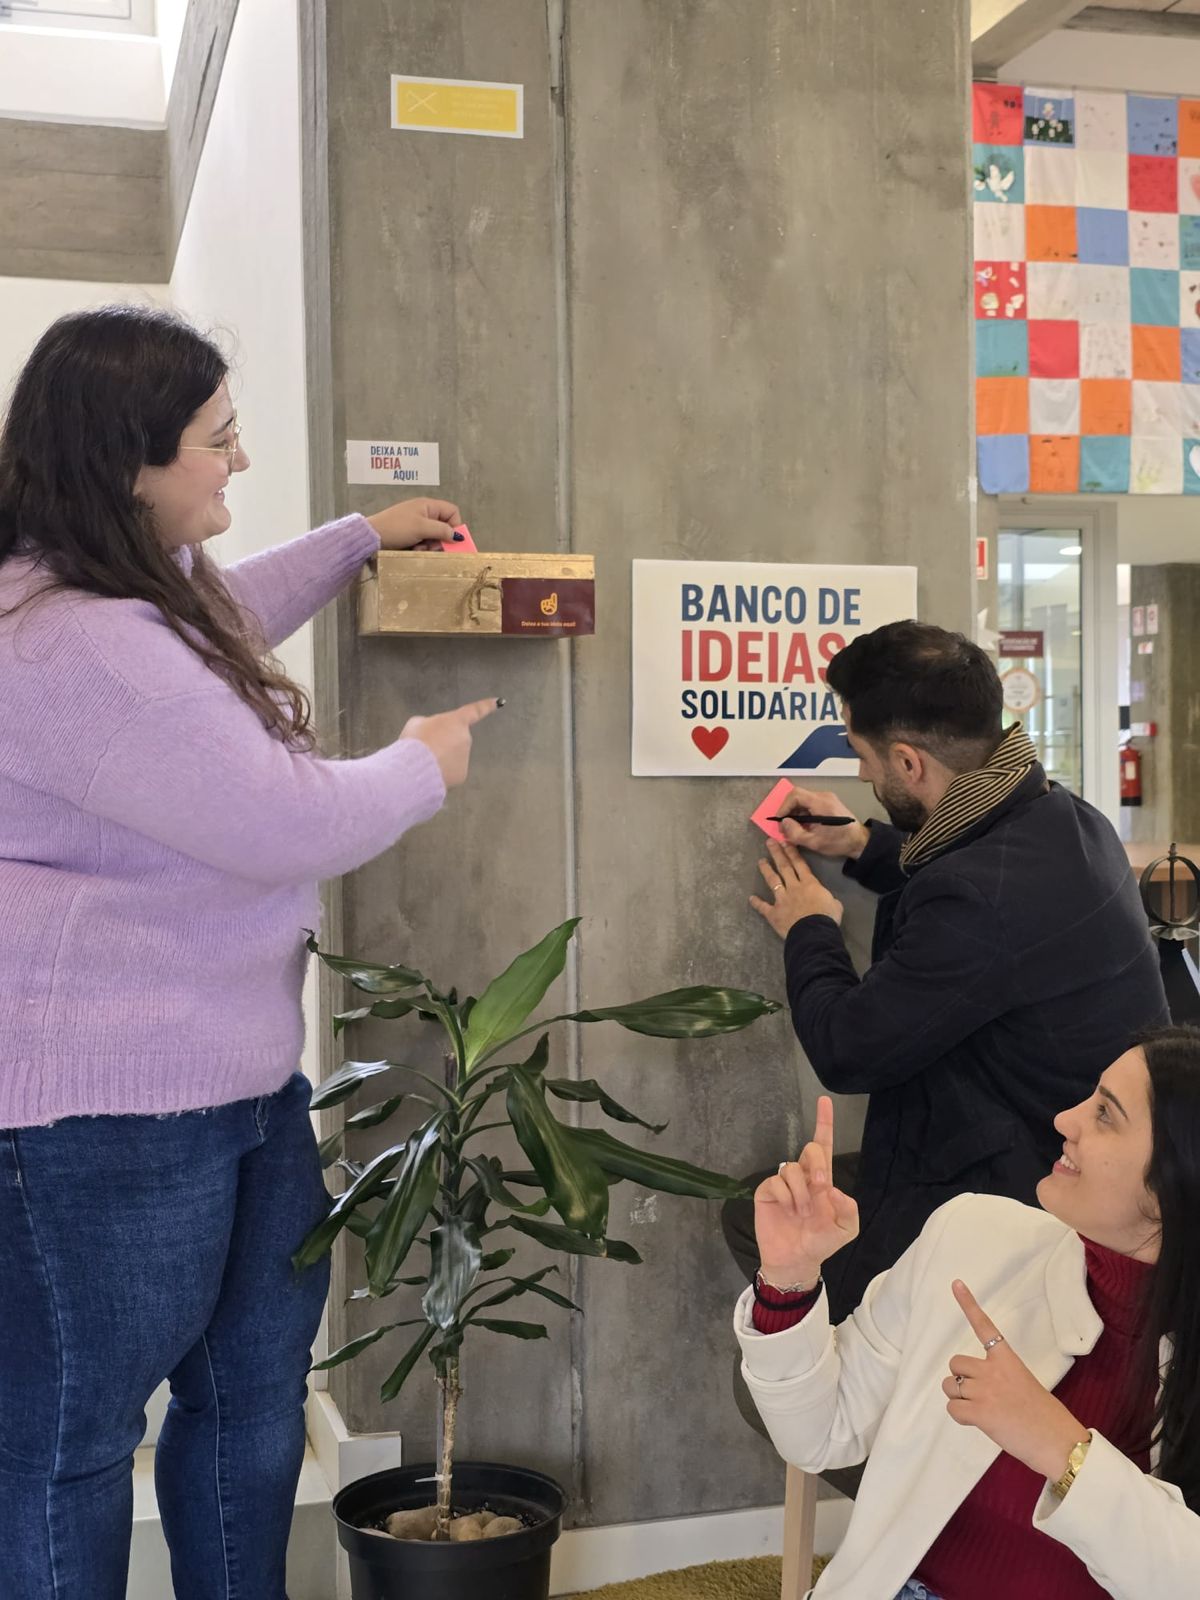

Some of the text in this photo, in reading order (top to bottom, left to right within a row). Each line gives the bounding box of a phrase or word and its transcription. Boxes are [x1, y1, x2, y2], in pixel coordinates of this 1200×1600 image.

[370, 446, 418, 456] DEIXA A TUA
[370, 457, 402, 470] IDEIA
[393, 470, 418, 481] AQUI!
[681, 583, 861, 625] BANCO DE
[681, 629, 846, 685] IDEIAS
[681, 686, 842, 721] SOLIDÁRIA
